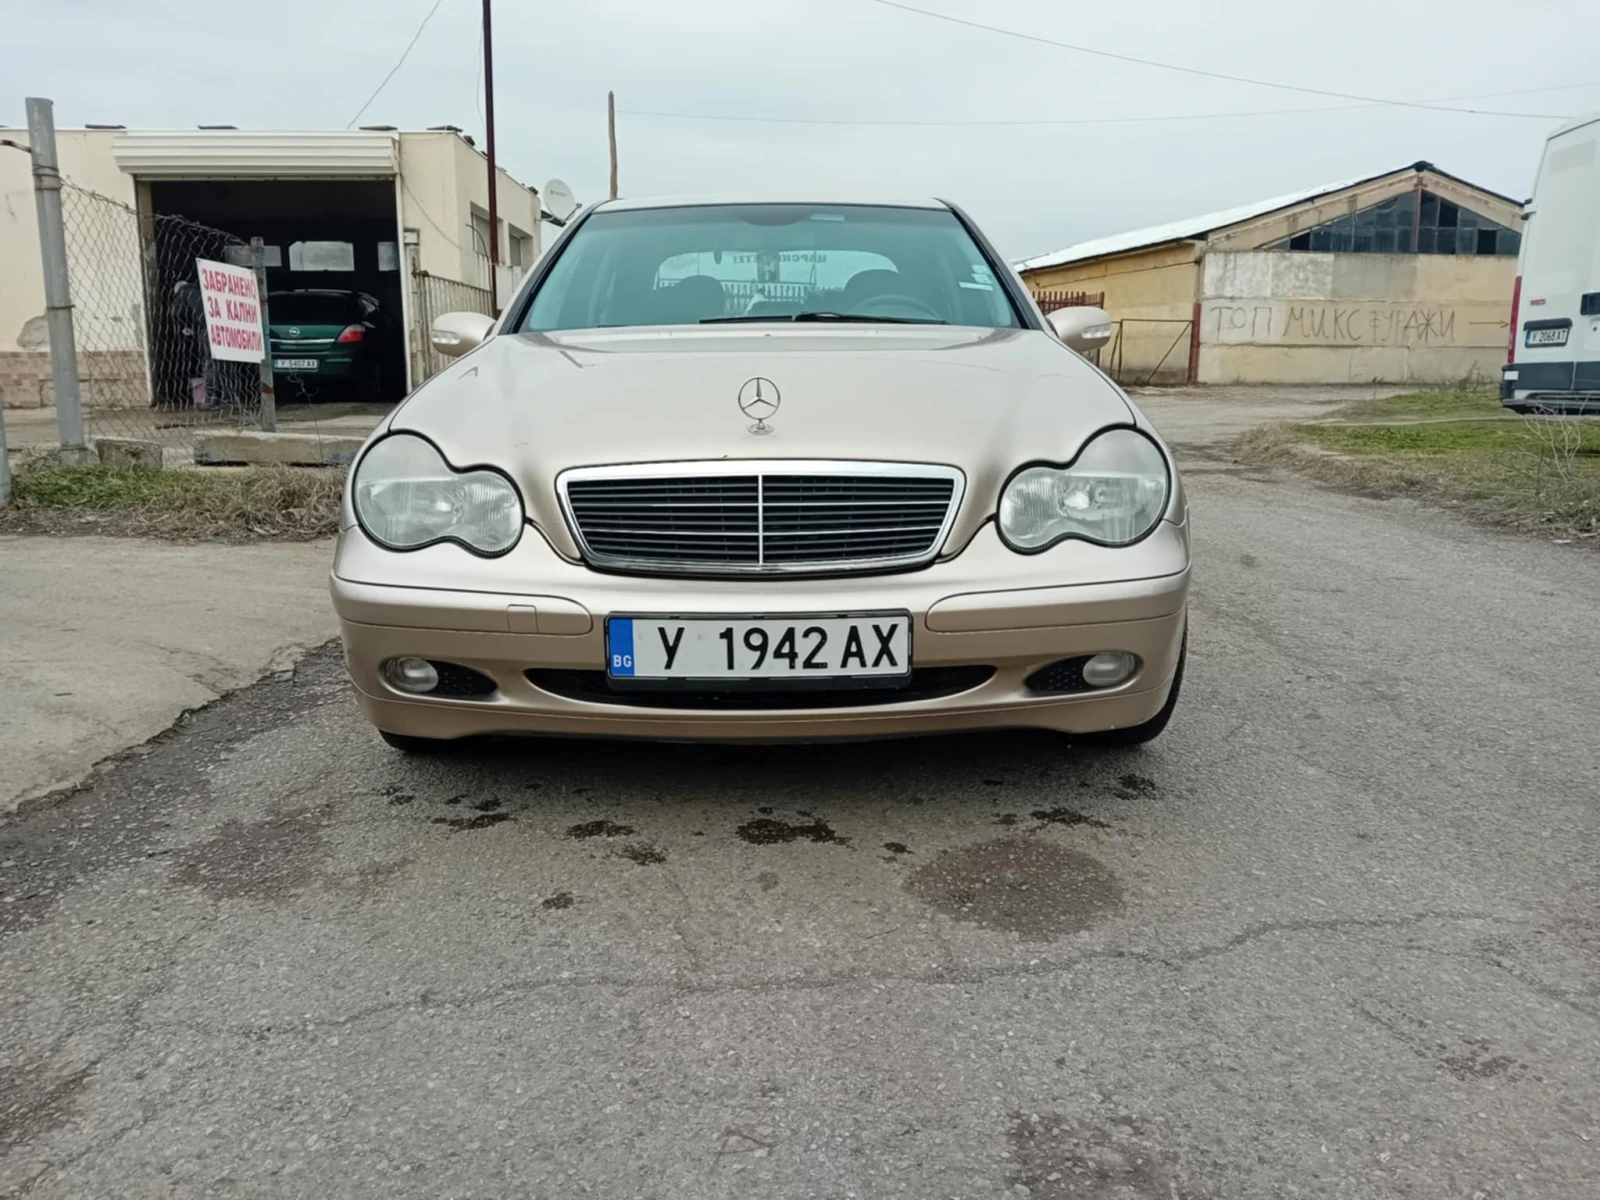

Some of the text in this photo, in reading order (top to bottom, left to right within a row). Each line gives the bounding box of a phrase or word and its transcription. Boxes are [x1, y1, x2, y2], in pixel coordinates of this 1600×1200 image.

[202, 268, 257, 300] ЗАБРАНЕНО
[207, 296, 258, 324] ЗА КАЛНИ
[1210, 305, 1272, 340] ТОП
[1282, 306, 1361, 341] МИКС
[211, 324, 263, 352] АВТОМОБИЛИ
[613, 654, 633, 668] BG
[719, 626, 828, 670] 1942
[840, 624, 899, 669] AX
